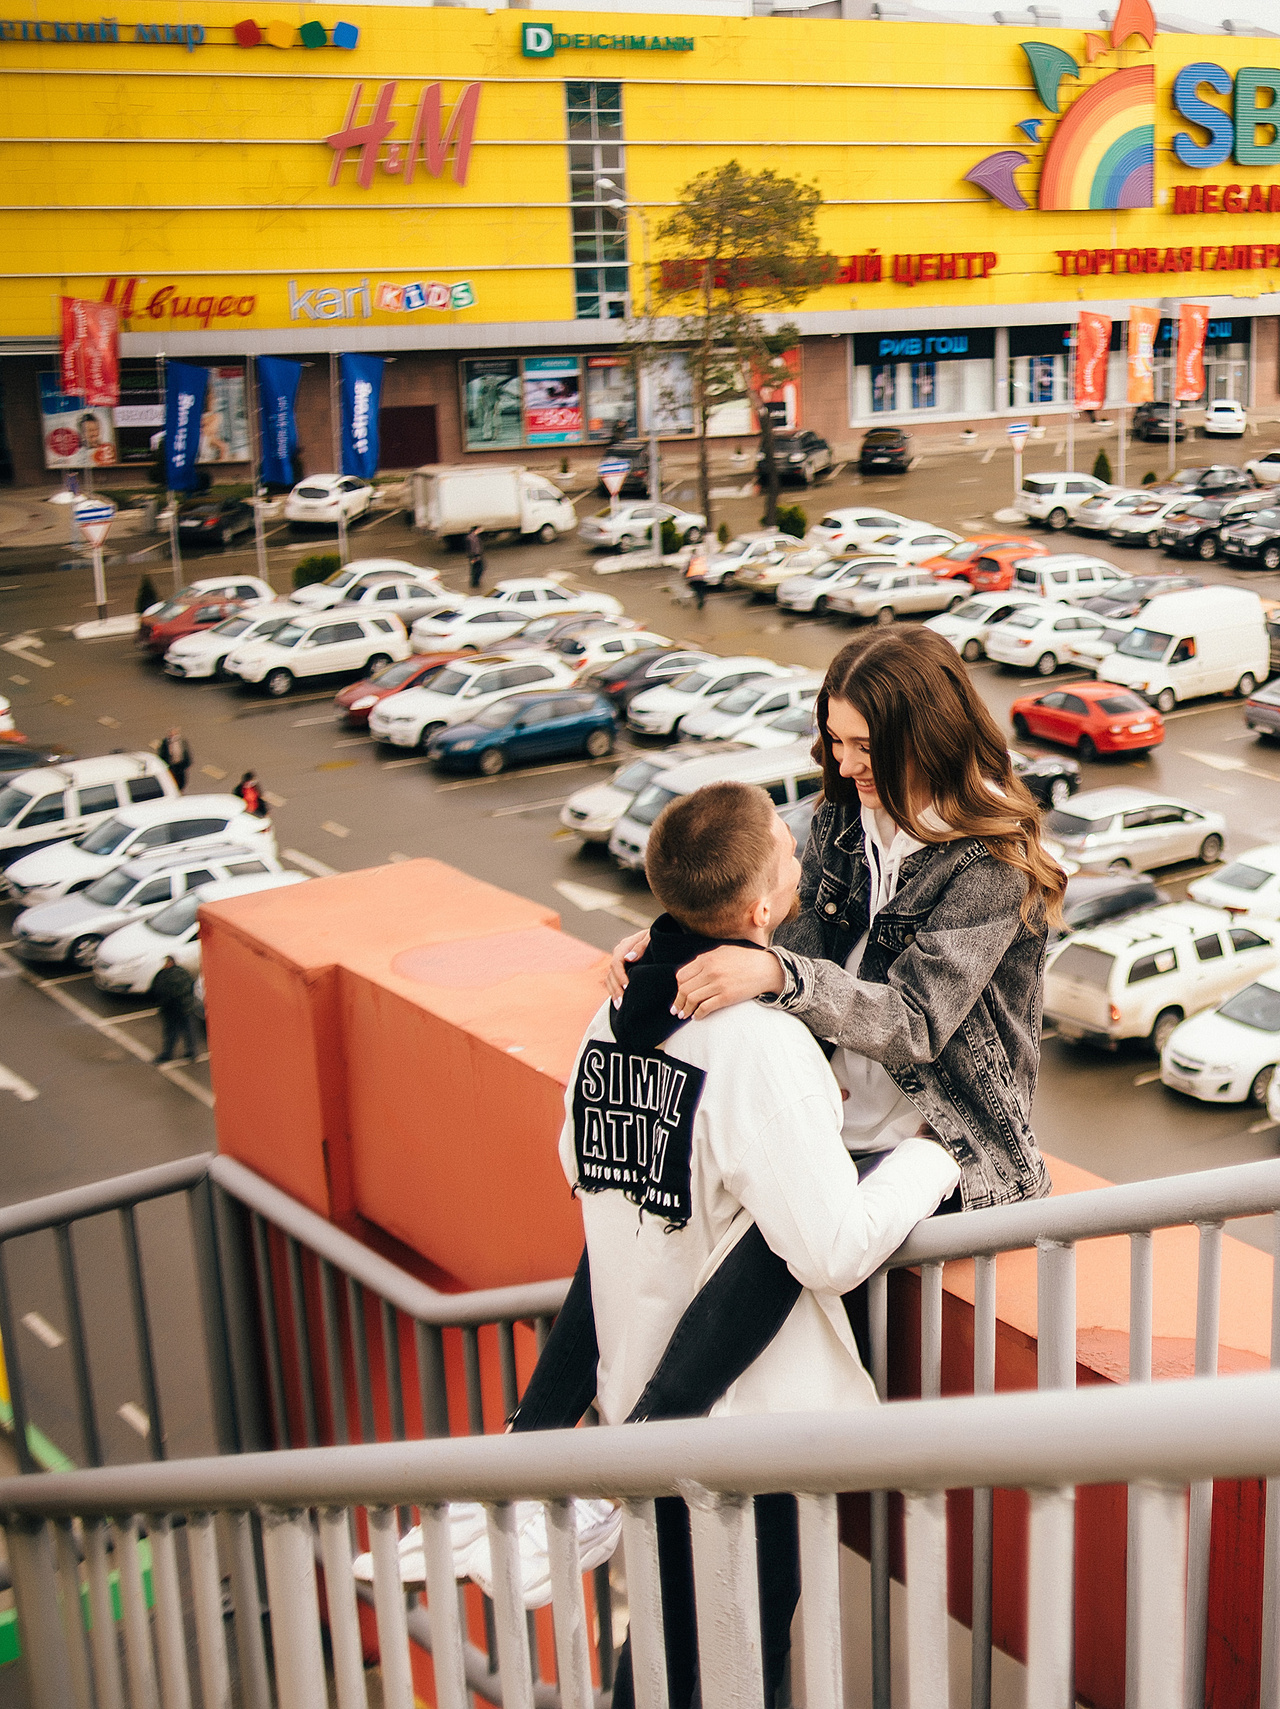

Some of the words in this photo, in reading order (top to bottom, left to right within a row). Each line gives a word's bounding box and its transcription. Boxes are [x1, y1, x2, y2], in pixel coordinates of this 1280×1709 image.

[135, 24, 204, 53] мир
[554, 33, 694, 51] DEICHMANN
[324, 80, 483, 190] H&M
[892, 251, 997, 287] ЦЕНТР
[1054, 247, 1194, 277] ТОРГОВАЯ
[287, 277, 372, 321] kari
[879, 338, 923, 356] РИВ
[924, 334, 968, 354] ГОШ
